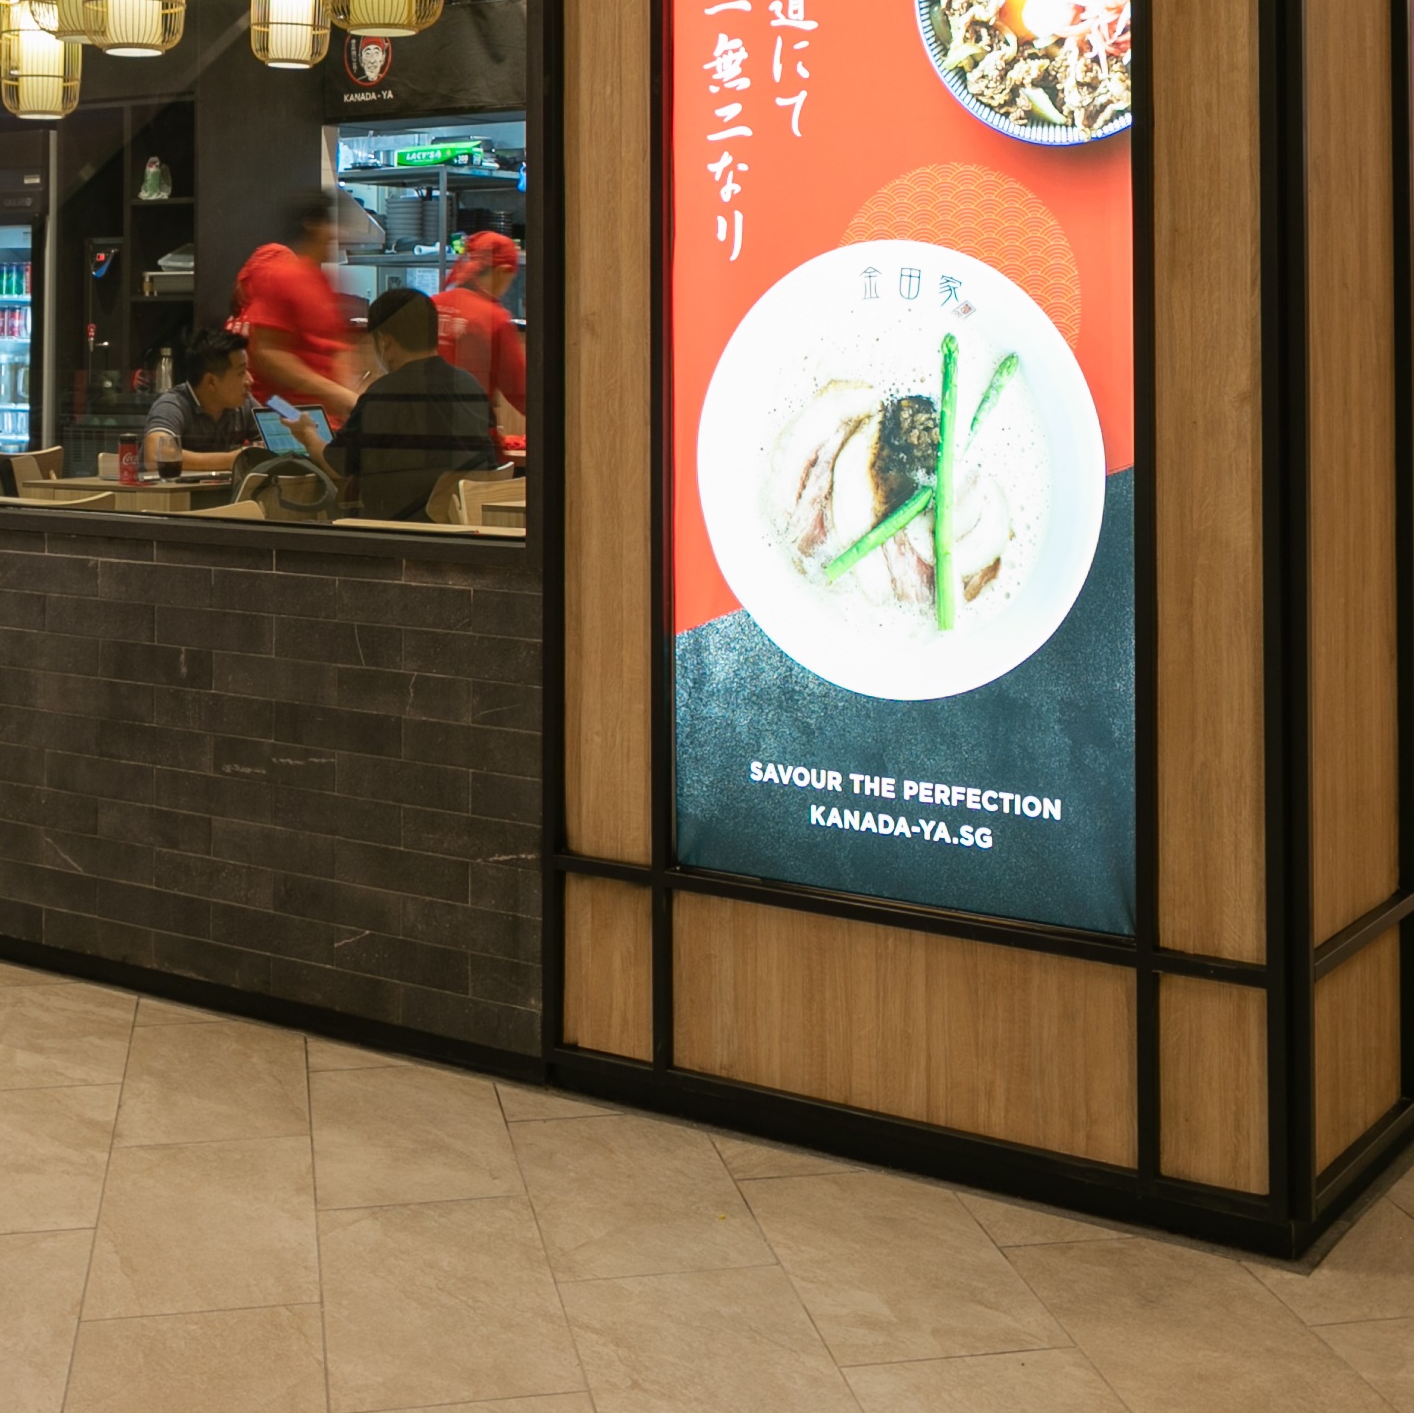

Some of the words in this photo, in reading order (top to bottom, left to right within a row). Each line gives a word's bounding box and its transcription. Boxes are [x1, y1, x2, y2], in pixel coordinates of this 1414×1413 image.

[749, 760, 843, 794] SAVOUR
[849, 772, 896, 800] THE
[903, 778, 1063, 822] PERFECTION
[809, 804, 994, 850] KANADA-YA.SG
